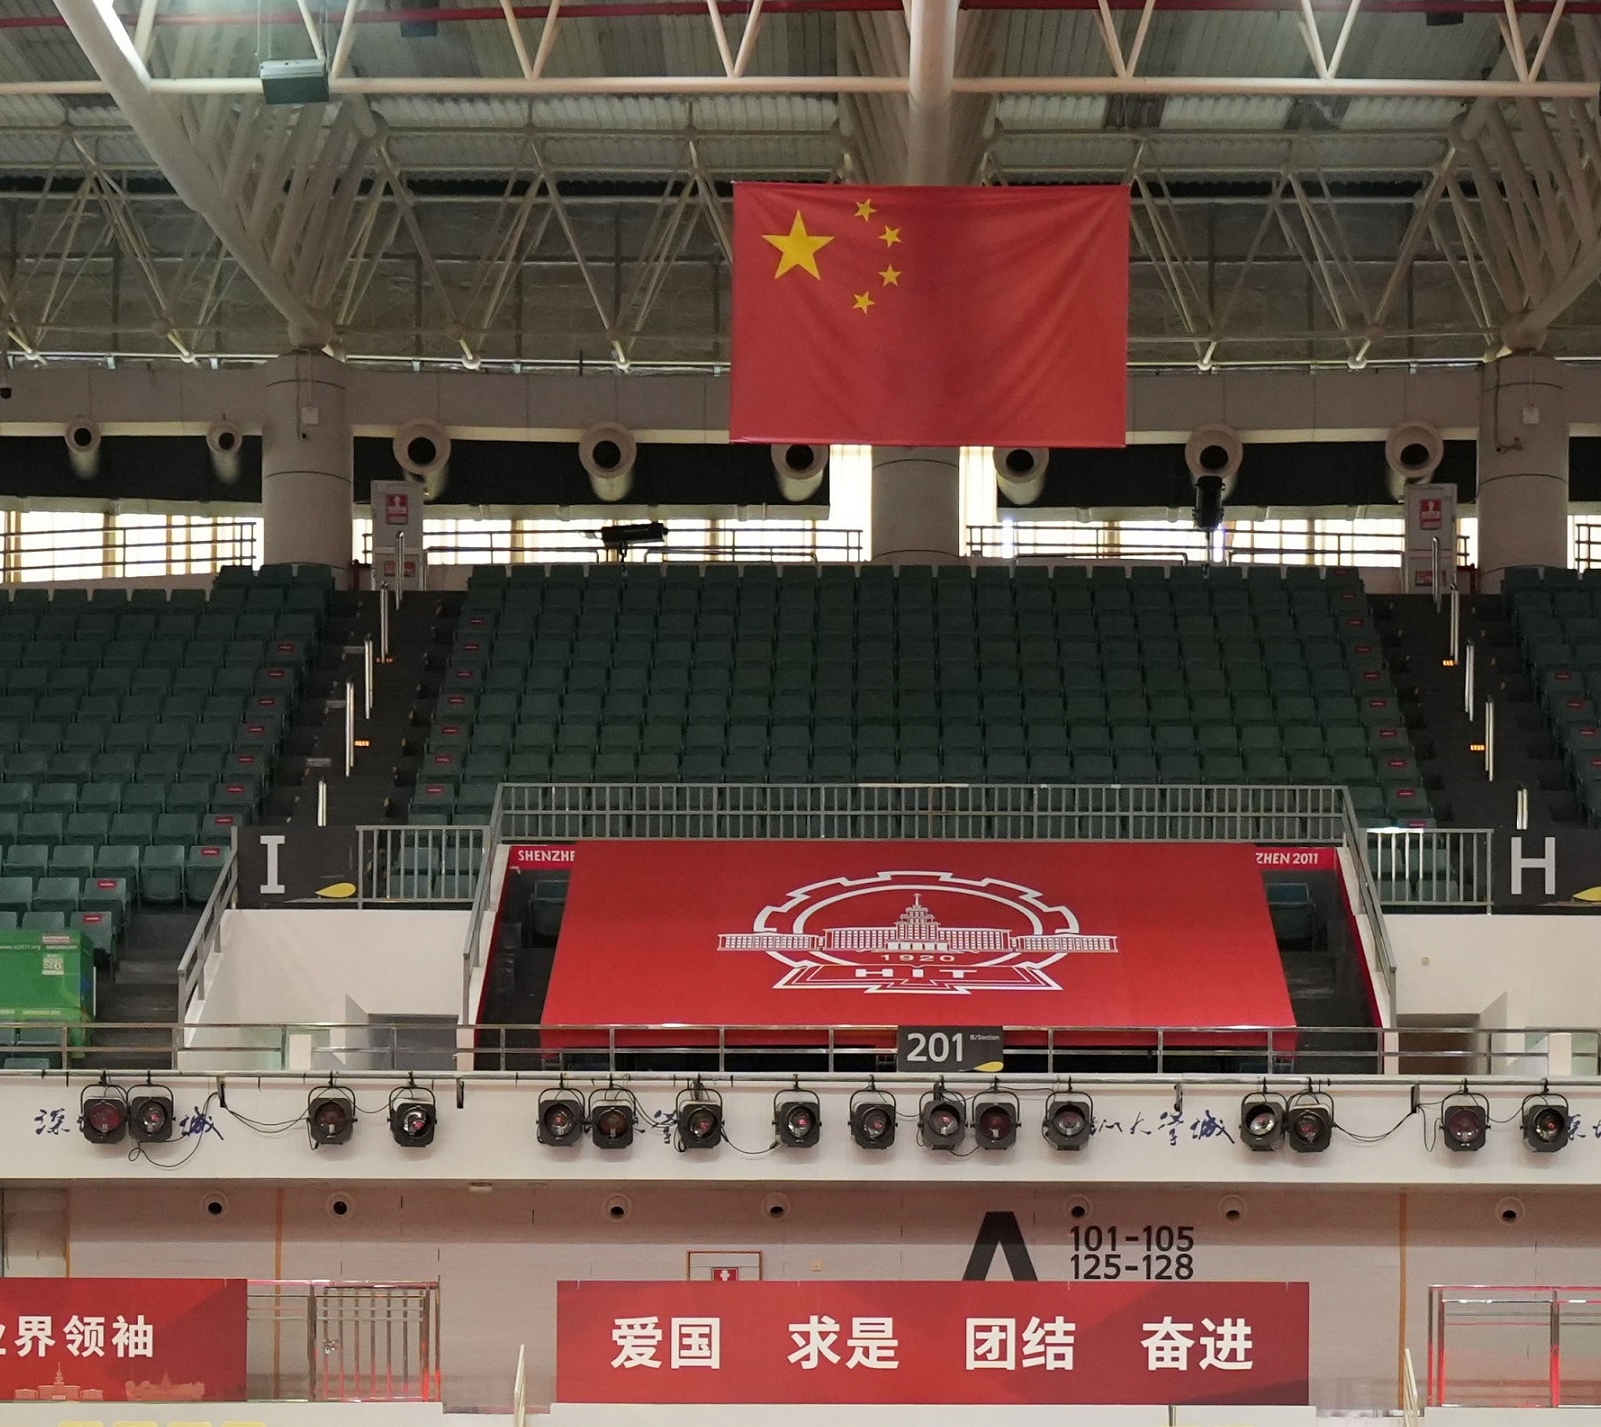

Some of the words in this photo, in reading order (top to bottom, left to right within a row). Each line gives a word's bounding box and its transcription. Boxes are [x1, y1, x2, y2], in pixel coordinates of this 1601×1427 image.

[260, 835, 285, 894] I
[1292, 853, 1318, 864] 2011
[1511, 837, 1556, 895] H
[880, 954, 955, 962] 1920
[855, 968, 977, 978] HIT
[907, 1032, 963, 1062] 201
[1070, 1225, 1194, 1252] 101-105
[1070, 1254, 1194, 1281] 125-128
[610, 1317, 721, 1371] 爱国
[787, 1316, 900, 1371] 求是
[964, 1317, 1077, 1371] 团结
[1141, 1317, 1254, 1371] 奋进
